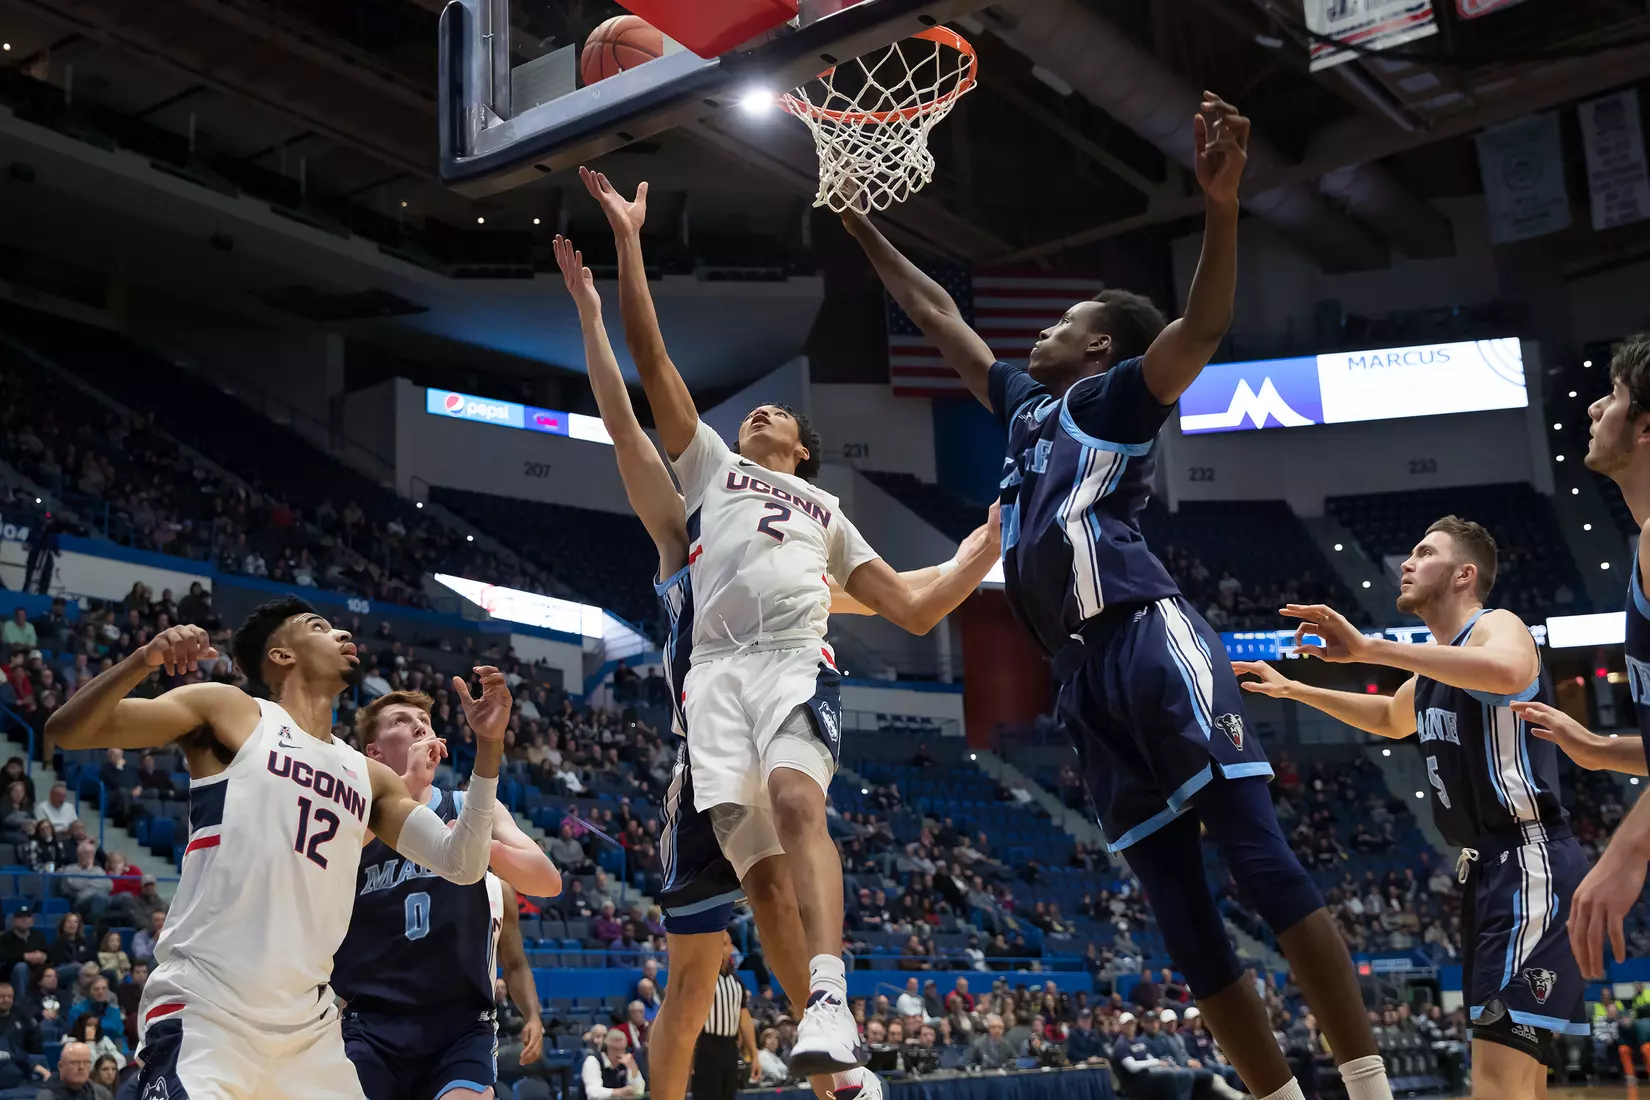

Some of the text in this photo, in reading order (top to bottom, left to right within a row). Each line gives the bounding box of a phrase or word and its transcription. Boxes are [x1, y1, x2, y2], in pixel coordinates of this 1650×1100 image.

[1347, 349, 1451, 371] MARCUS
[466, 402, 509, 420] pepsi
[844, 443, 869, 458] 231
[523, 461, 552, 479] 207
[1187, 466, 1215, 482] 232
[726, 472, 832, 529] UCONN
[757, 502, 792, 543] 2
[348, 598, 370, 614] 105
[1417, 707, 1462, 746] AINE
[266, 750, 367, 823] UCONN
[1426, 755, 1452, 809] 5
[294, 795, 341, 871] 12
[404, 891, 431, 941] 0
[1511, 1027, 1539, 1044] adidas
